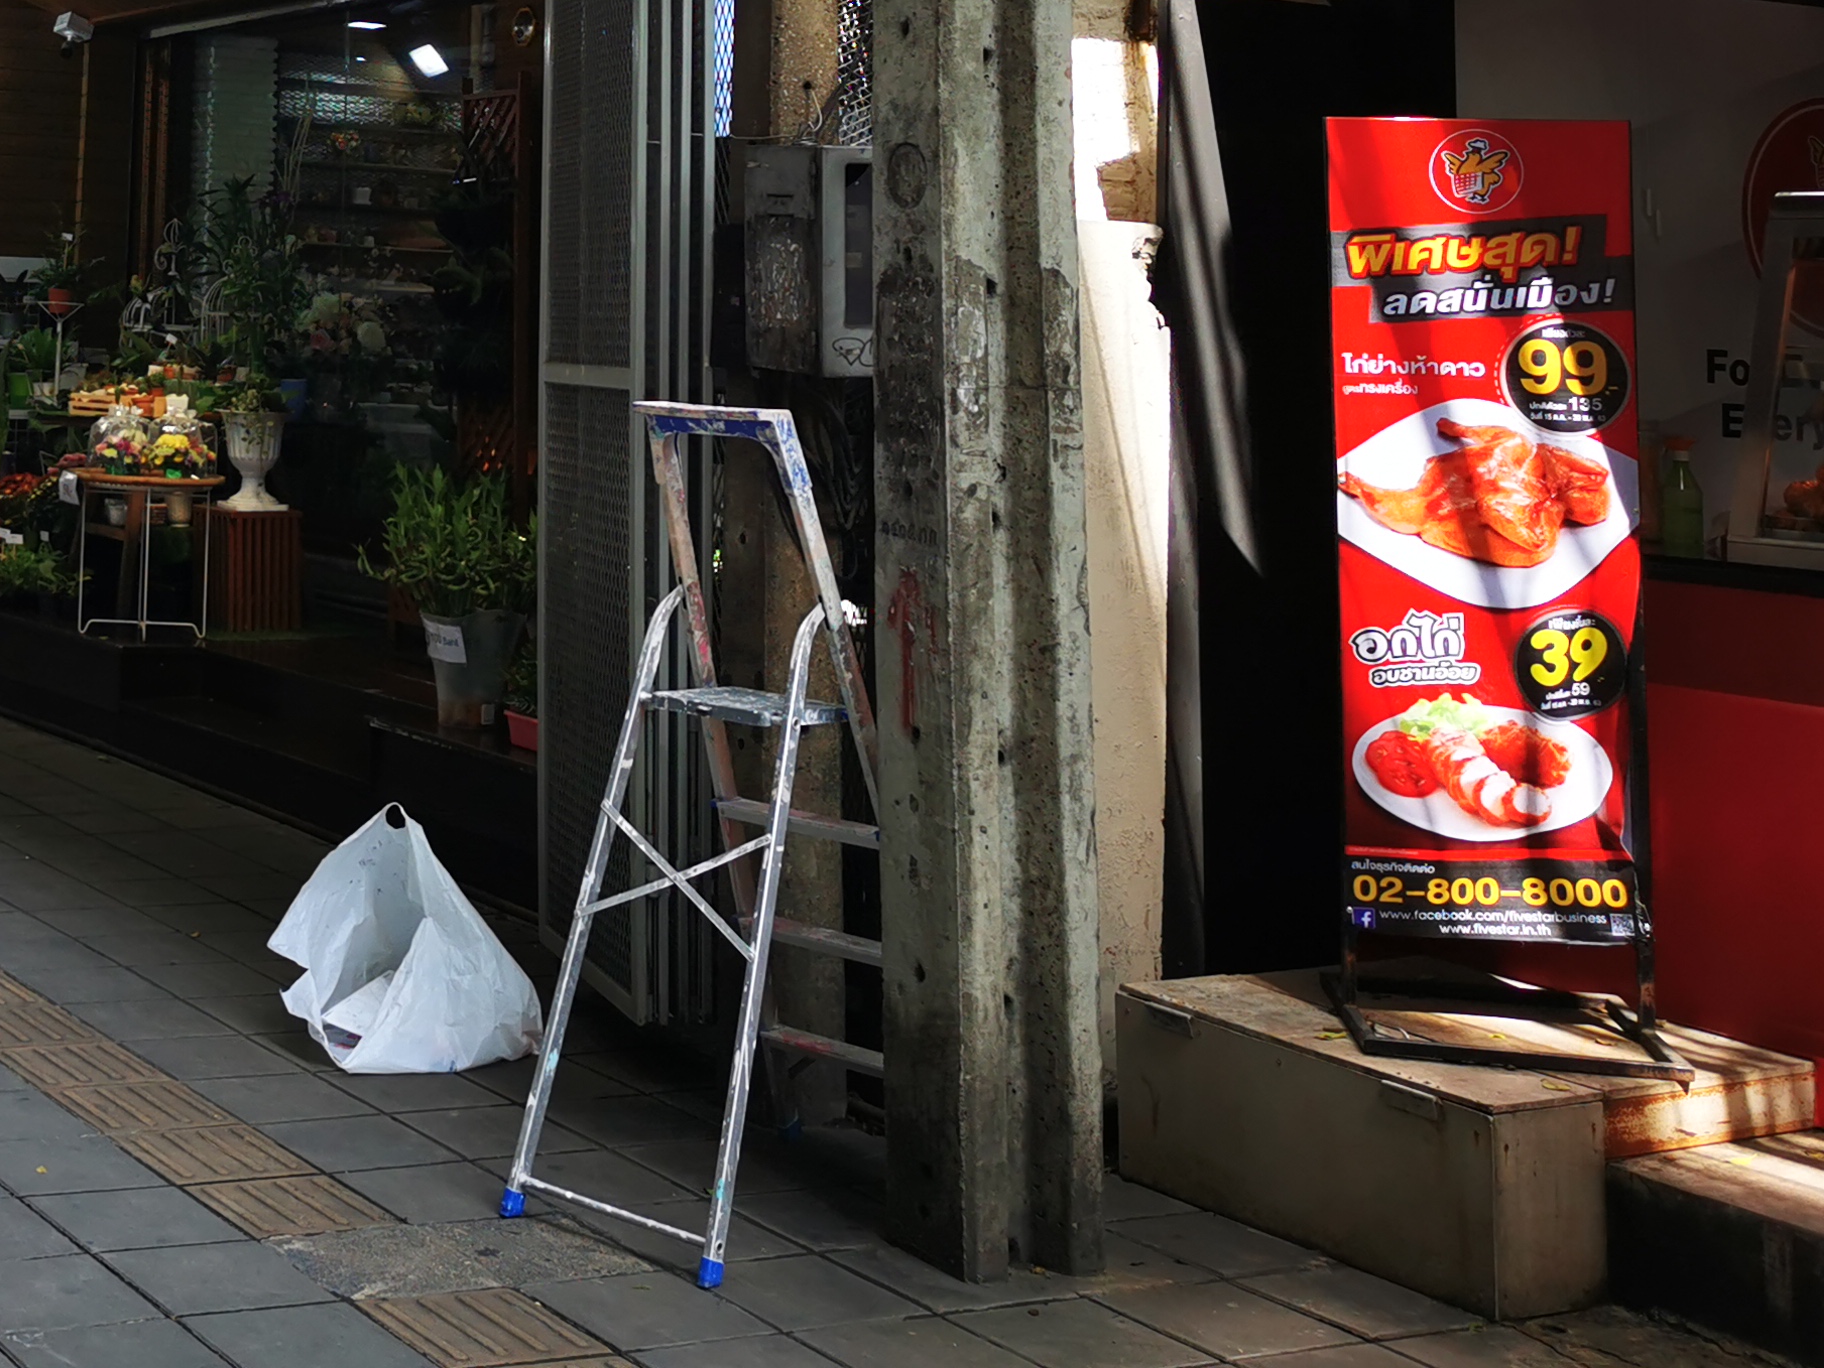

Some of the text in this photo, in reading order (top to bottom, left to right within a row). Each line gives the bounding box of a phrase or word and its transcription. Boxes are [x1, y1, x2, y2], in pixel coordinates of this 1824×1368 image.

[1346, 226, 1581, 282] พิเศษสุด!
[1383, 274, 1616, 316] ลดสนั่นเมือง!
[1341, 352, 1487, 377] ไก่ย่างห้าดาว
[1706, 348, 1750, 386] Fo
[1567, 395, 1603, 411] 135
[1351, 609, 1465, 664] อกไก่
[1371, 662, 1480, 687] อบชานอ้อย
[1570, 681, 1591, 696] 59
[1353, 874, 1628, 908] 02-800-8000
[1379, 909, 1608, 924] www.facebook.com/fivestarbusiness
[1439, 923, 1552, 937] www.fivestar.in.th
